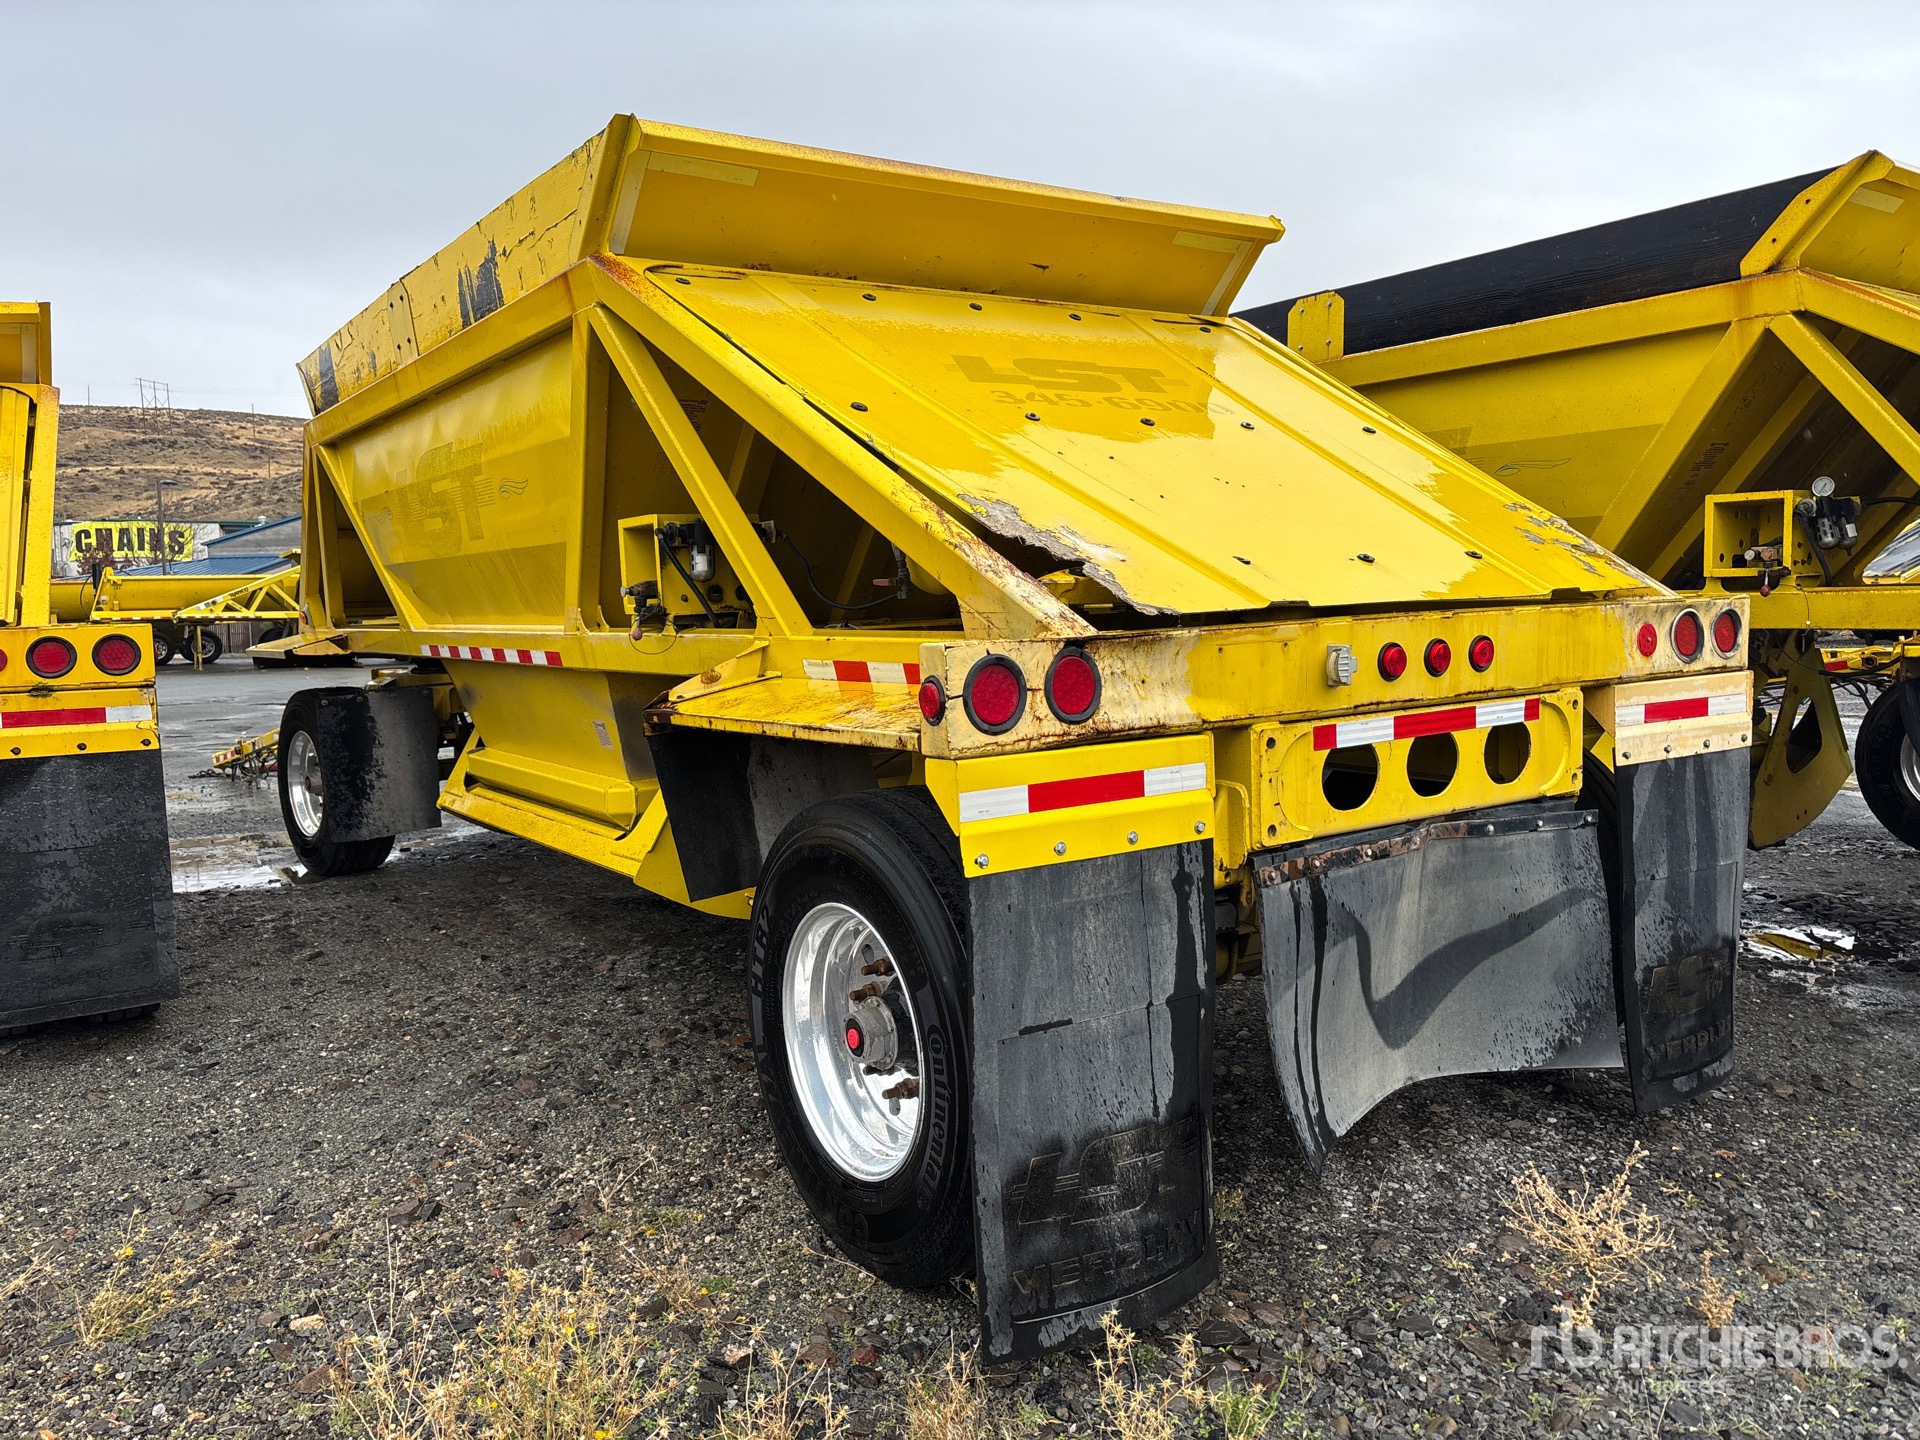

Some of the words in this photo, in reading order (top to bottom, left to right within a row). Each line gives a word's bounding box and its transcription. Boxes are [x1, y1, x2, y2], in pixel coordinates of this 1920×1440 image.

[944, 354, 1189, 394] LST
[75, 527, 185, 554] CHAINS
[921, 1023, 953, 1200] Continental
